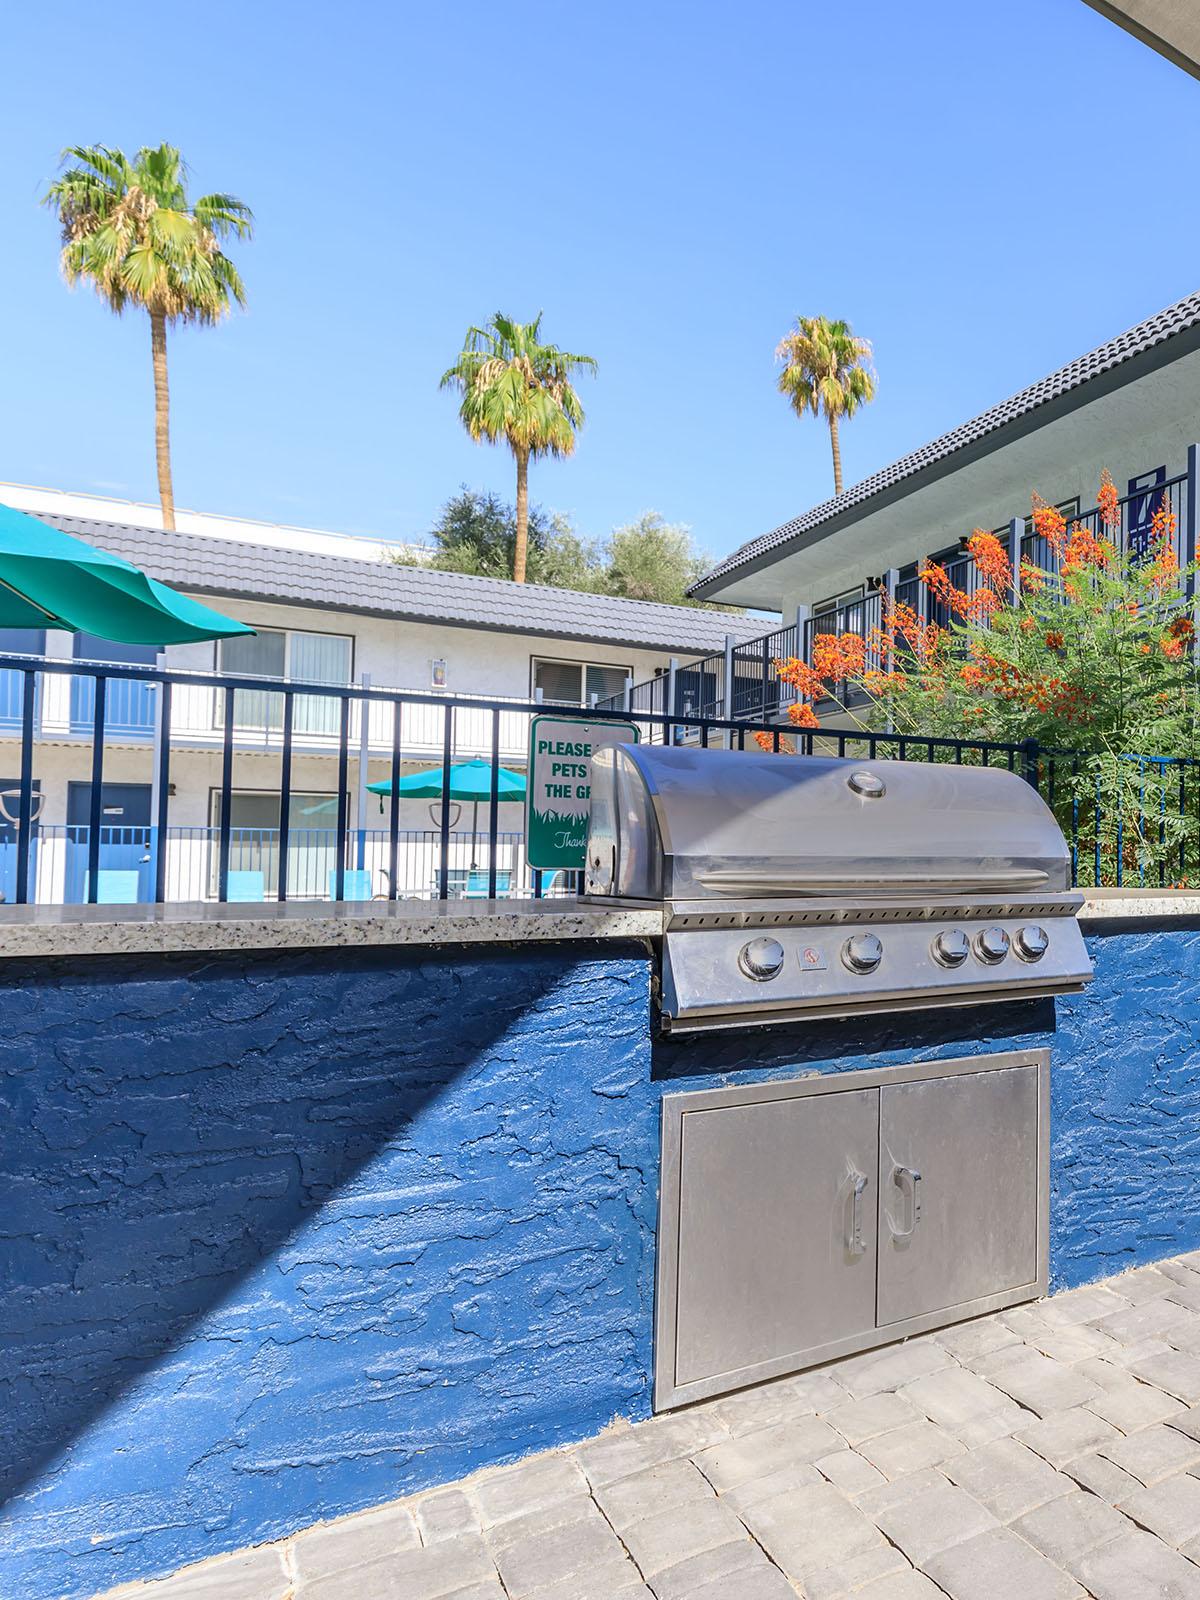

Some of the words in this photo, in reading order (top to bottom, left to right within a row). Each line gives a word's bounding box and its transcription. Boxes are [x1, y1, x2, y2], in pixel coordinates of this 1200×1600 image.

[1135, 471, 1158, 524] 7
[538, 740, 592, 757] PLEASE
[552, 763, 587, 778] PETS
[545, 783, 572, 799] THE
